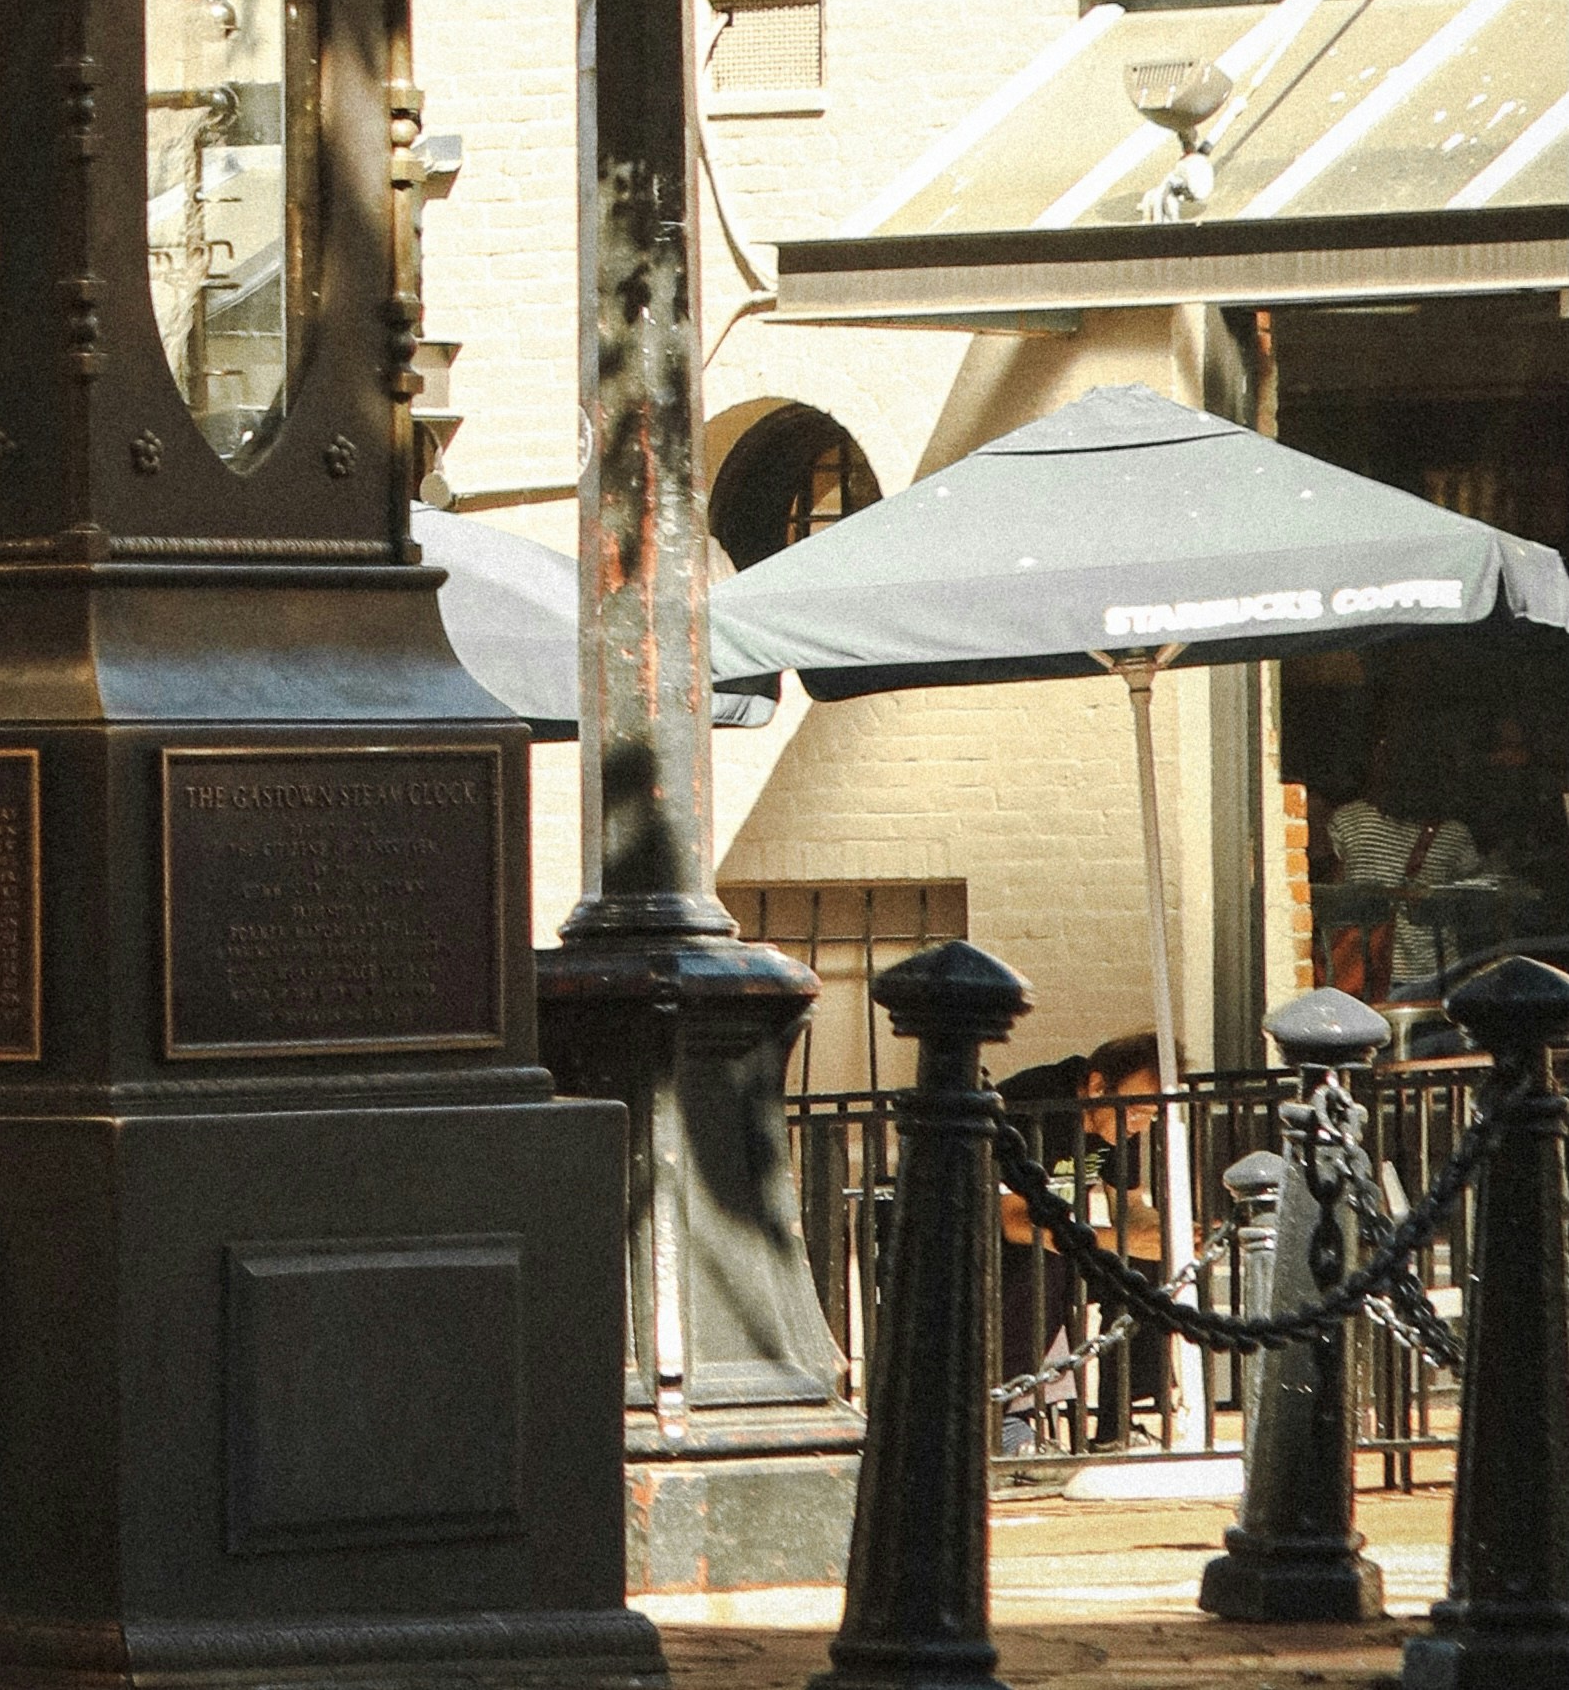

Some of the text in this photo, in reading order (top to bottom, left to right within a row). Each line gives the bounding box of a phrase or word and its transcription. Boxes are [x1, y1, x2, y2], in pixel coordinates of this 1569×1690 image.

[1104, 580, 1463, 636] STARBUCKS COFFEE
[184, 781, 477, 809] THE GASTOWN STEAM CLOCK
